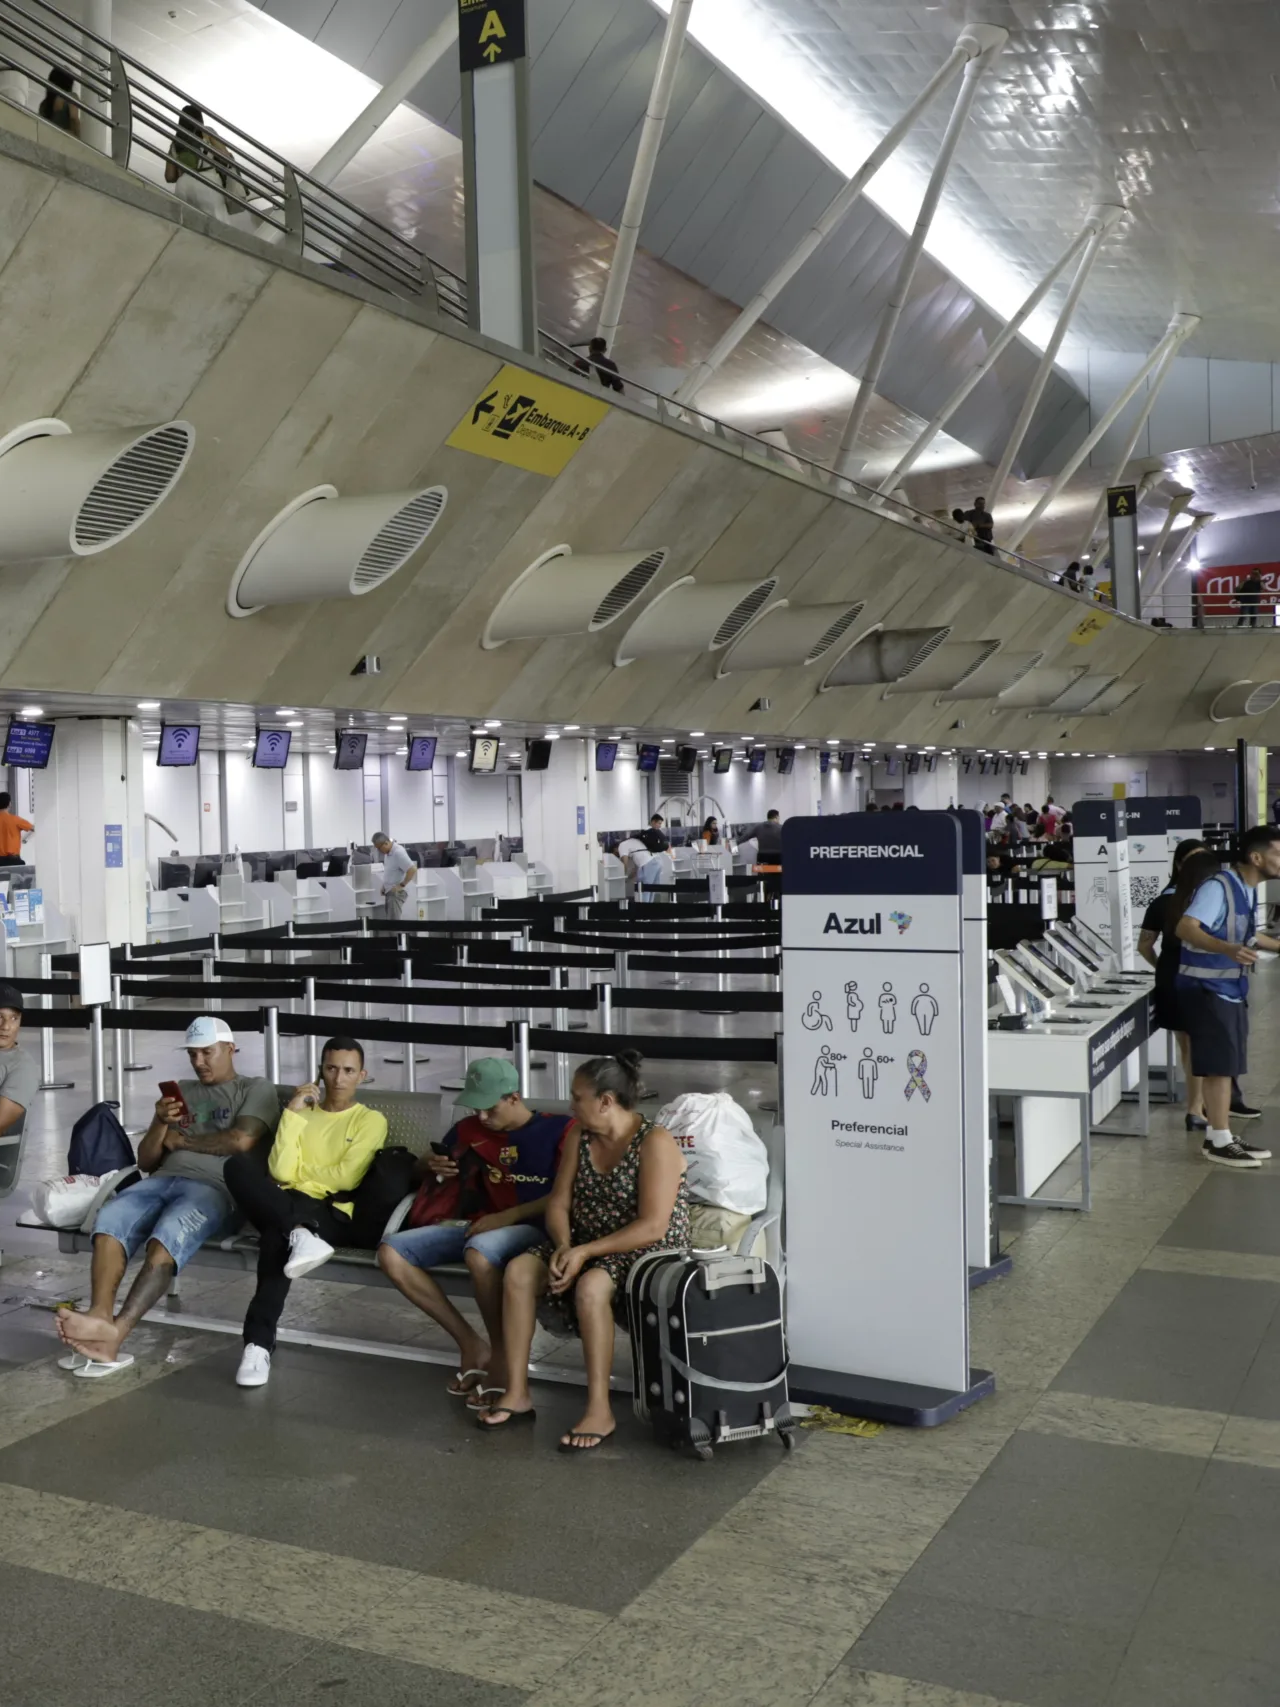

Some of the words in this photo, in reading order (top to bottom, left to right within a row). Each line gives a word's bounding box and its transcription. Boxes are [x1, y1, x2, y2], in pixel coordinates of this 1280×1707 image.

[479, 10, 506, 43] A
[525, 408, 570, 435] Embarque
[569, 424, 579, 438] A
[579, 427, 590, 441] B
[516, 424, 547, 442] Departures
[1116, 496, 1128, 508] A
[810, 845, 925, 859] PREFERENCIAL
[823, 912, 882, 935] Azul
[830, 1053, 848, 1061] 80+
[876, 1055, 895, 1064] 60+
[831, 1120, 908, 1136] Preferencial
[835, 1139, 863, 1149] Special
[864, 1142, 905, 1152] Assistance
